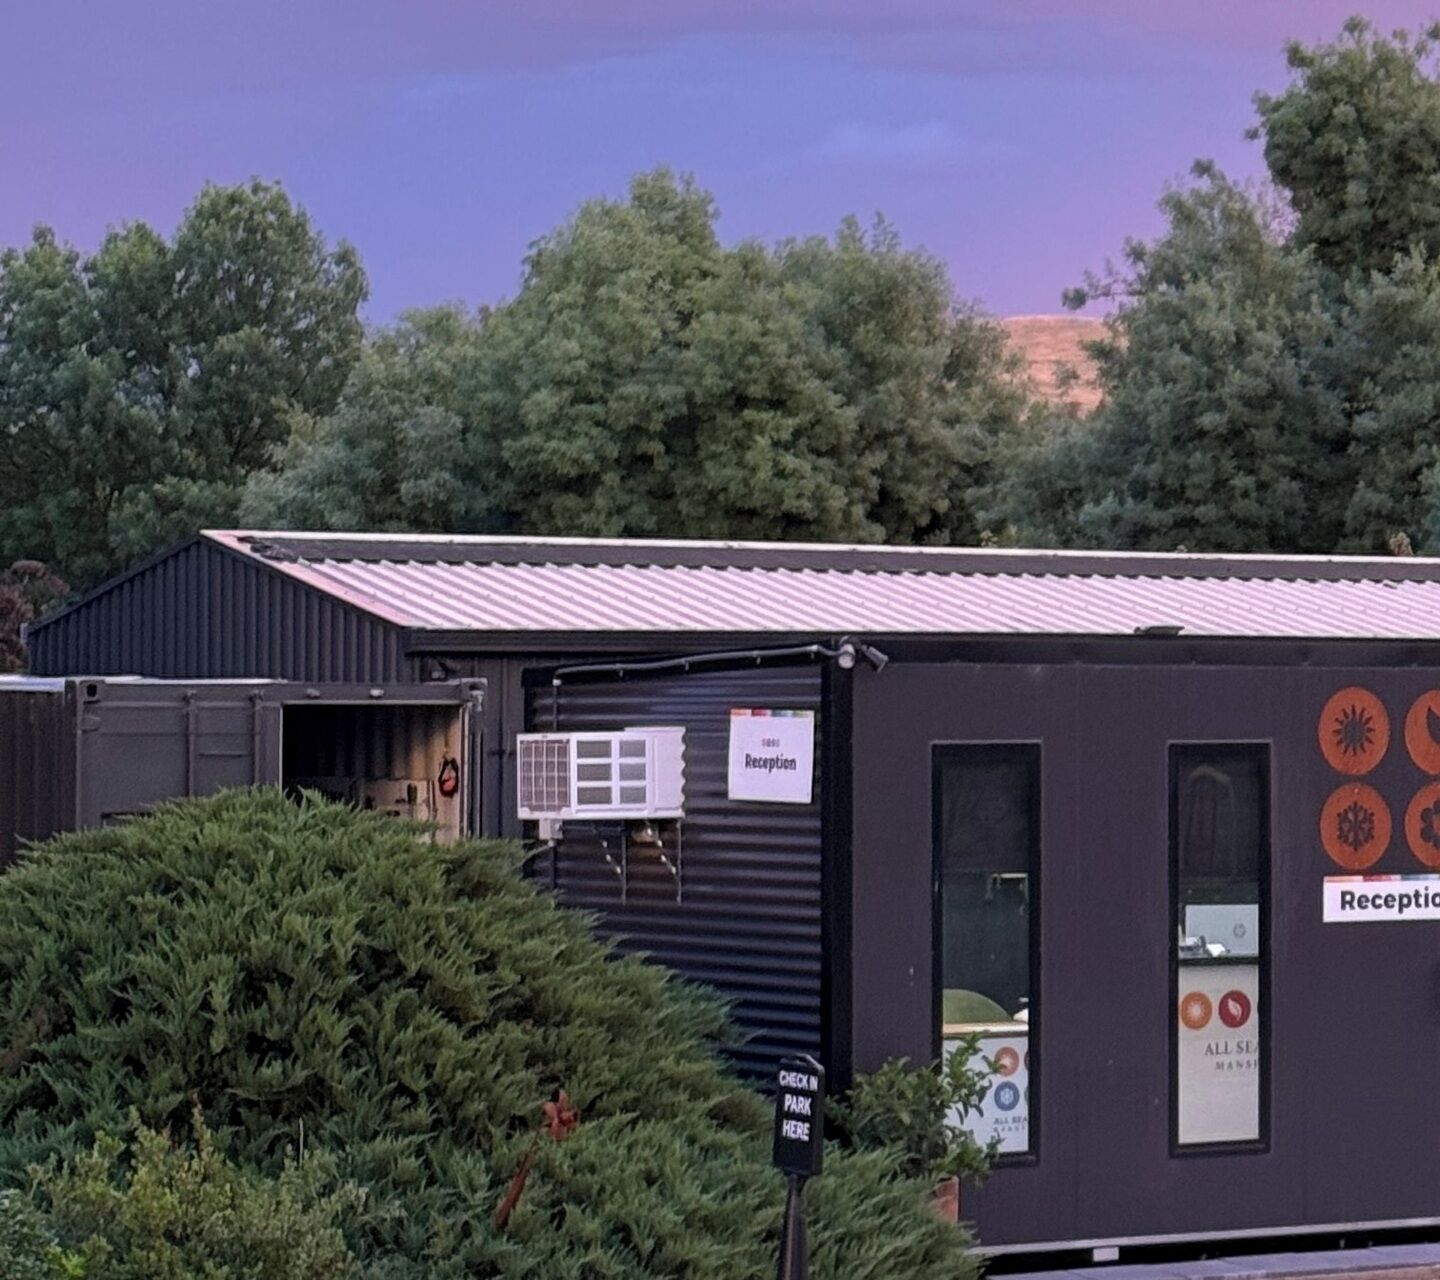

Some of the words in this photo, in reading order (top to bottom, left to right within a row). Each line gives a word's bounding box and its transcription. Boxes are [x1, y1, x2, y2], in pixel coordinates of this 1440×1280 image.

[745, 753, 797, 773] Reception
[1205, 1041, 1232, 1055] ALL
[780, 1070, 808, 1089] CHECK
[810, 1075, 818, 1091] IN
[785, 1094, 811, 1116] PARK
[782, 1120, 810, 1141] HERE
